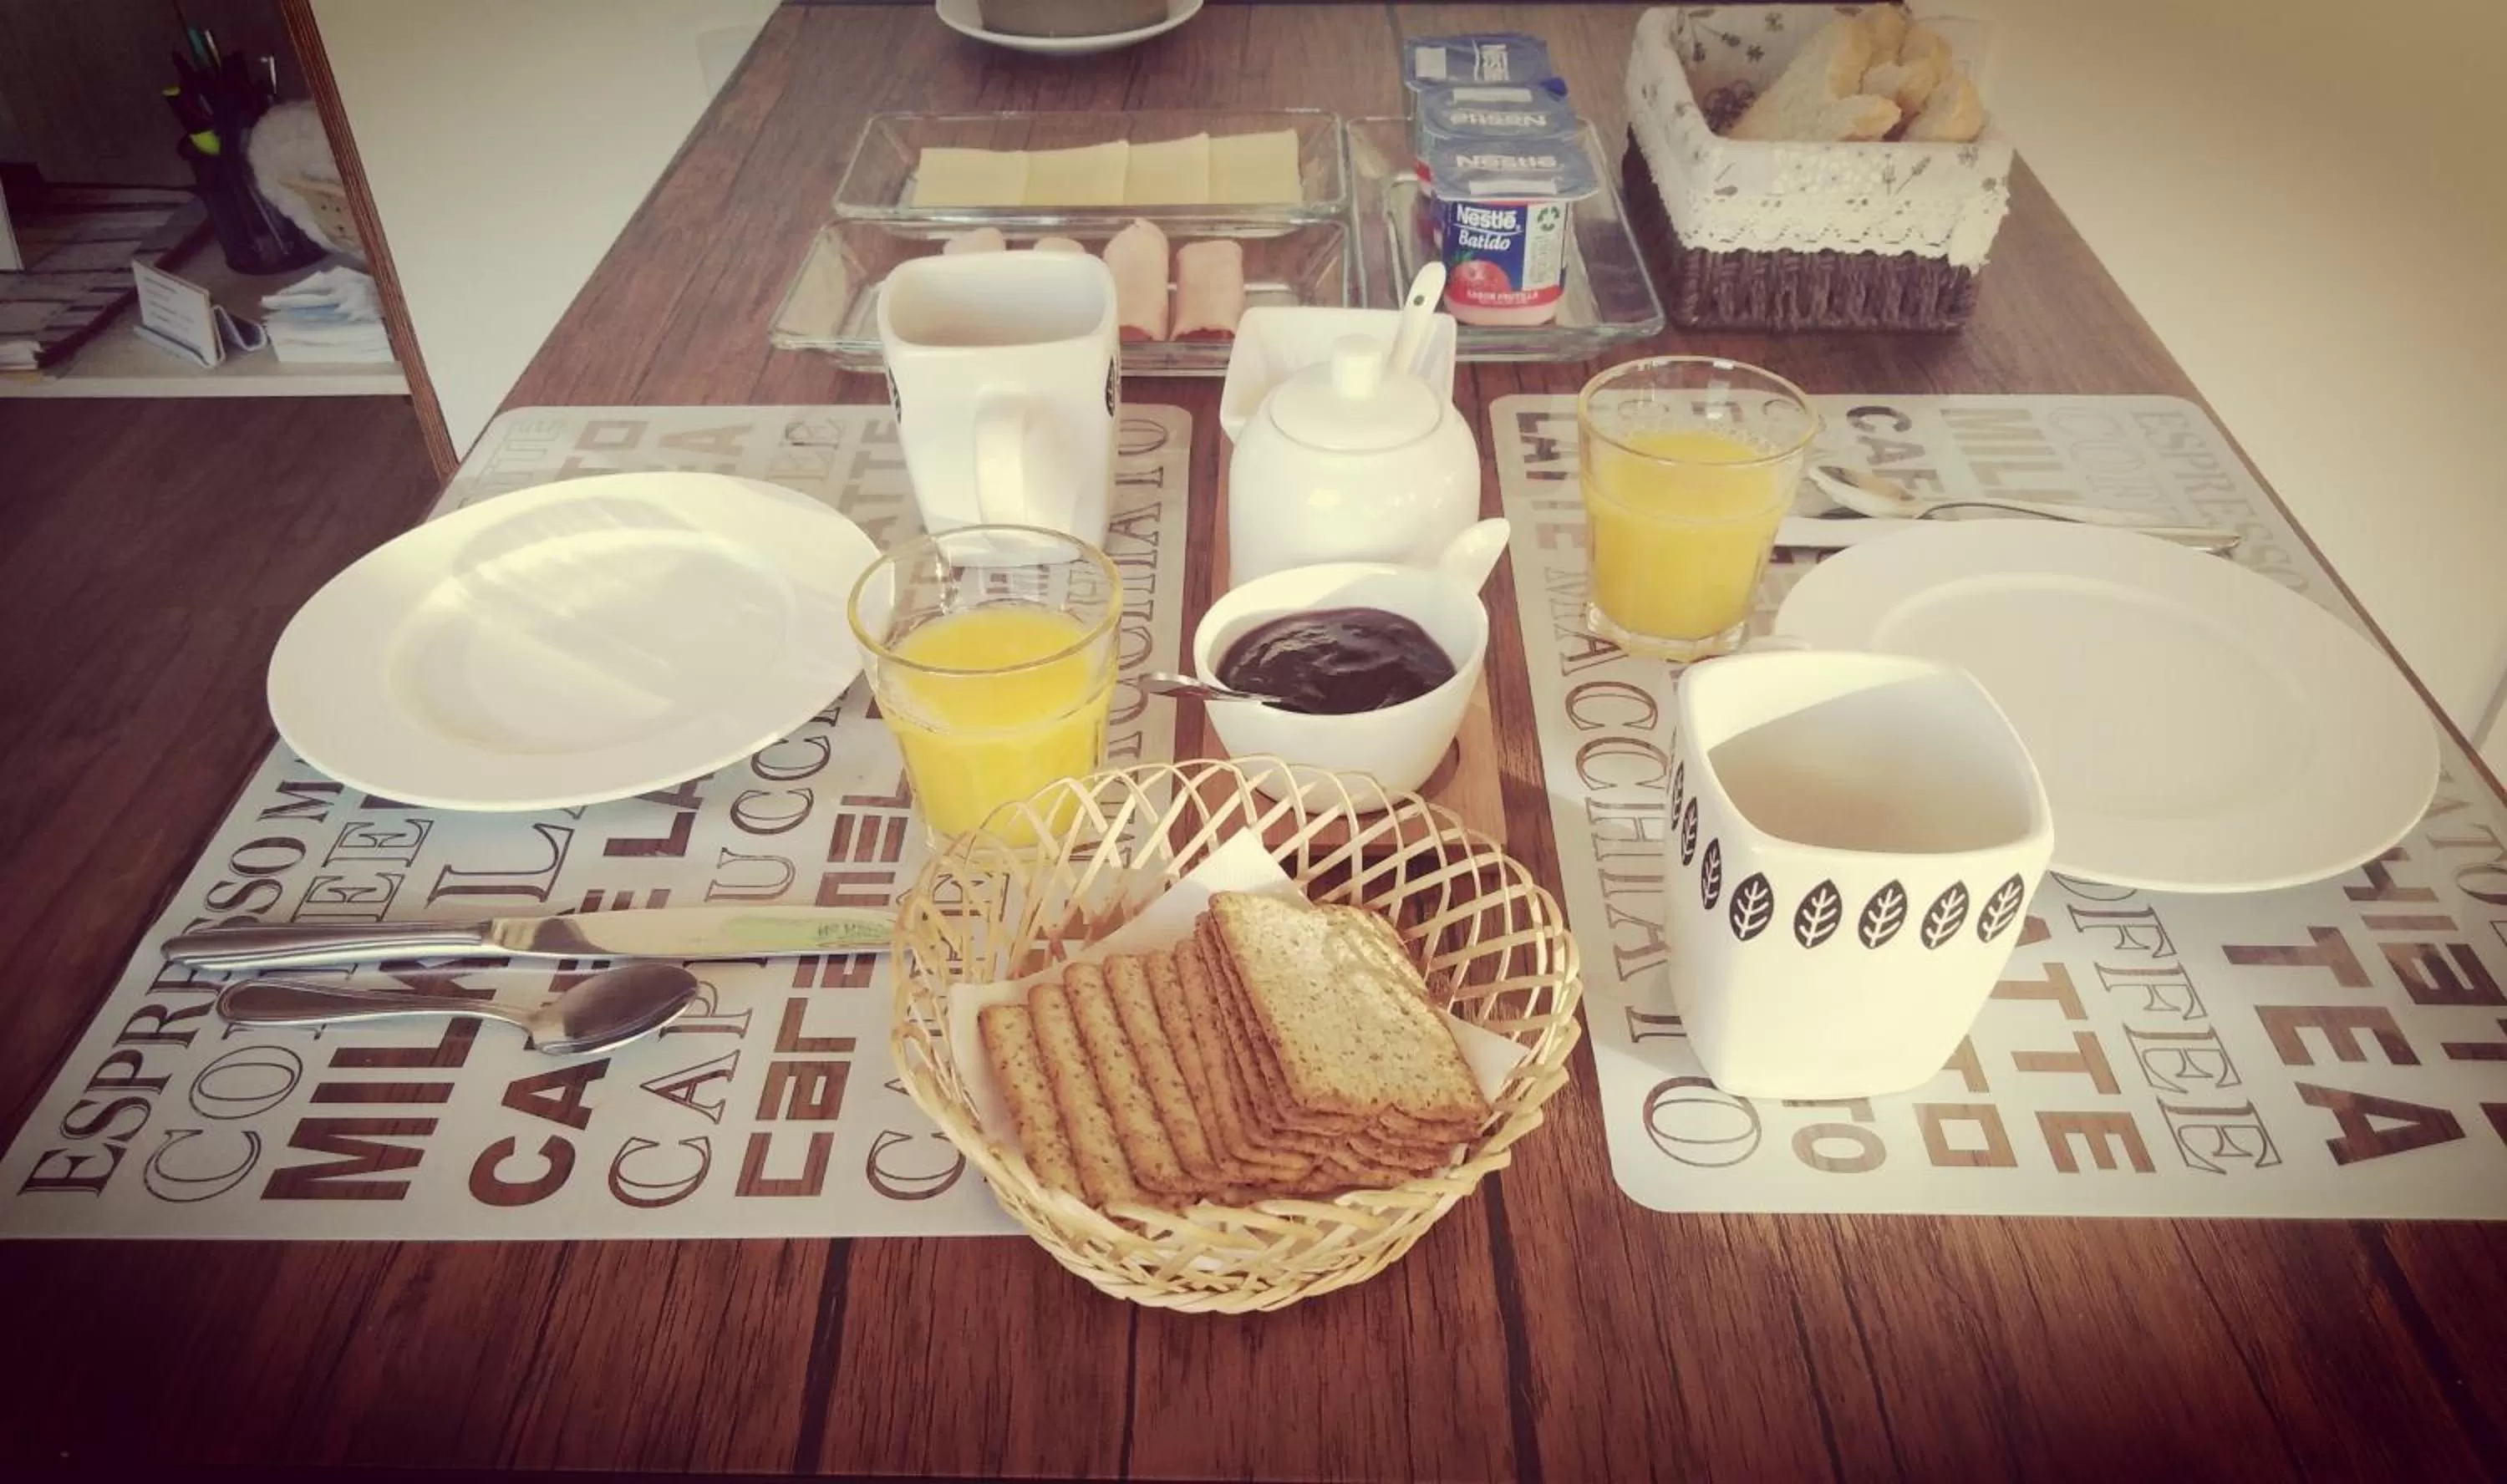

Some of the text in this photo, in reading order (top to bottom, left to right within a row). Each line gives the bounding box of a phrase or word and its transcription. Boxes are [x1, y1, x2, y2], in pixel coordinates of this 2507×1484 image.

[1457, 204, 1518, 231] Nestlé
[1458, 229, 1511, 251] Batido
[1846, 405, 1945, 493] CAF
[17, 836, 307, 1197] ESPRESO
[144, 818, 434, 1202] COEE
[2221, 926, 2466, 1166] TEA
